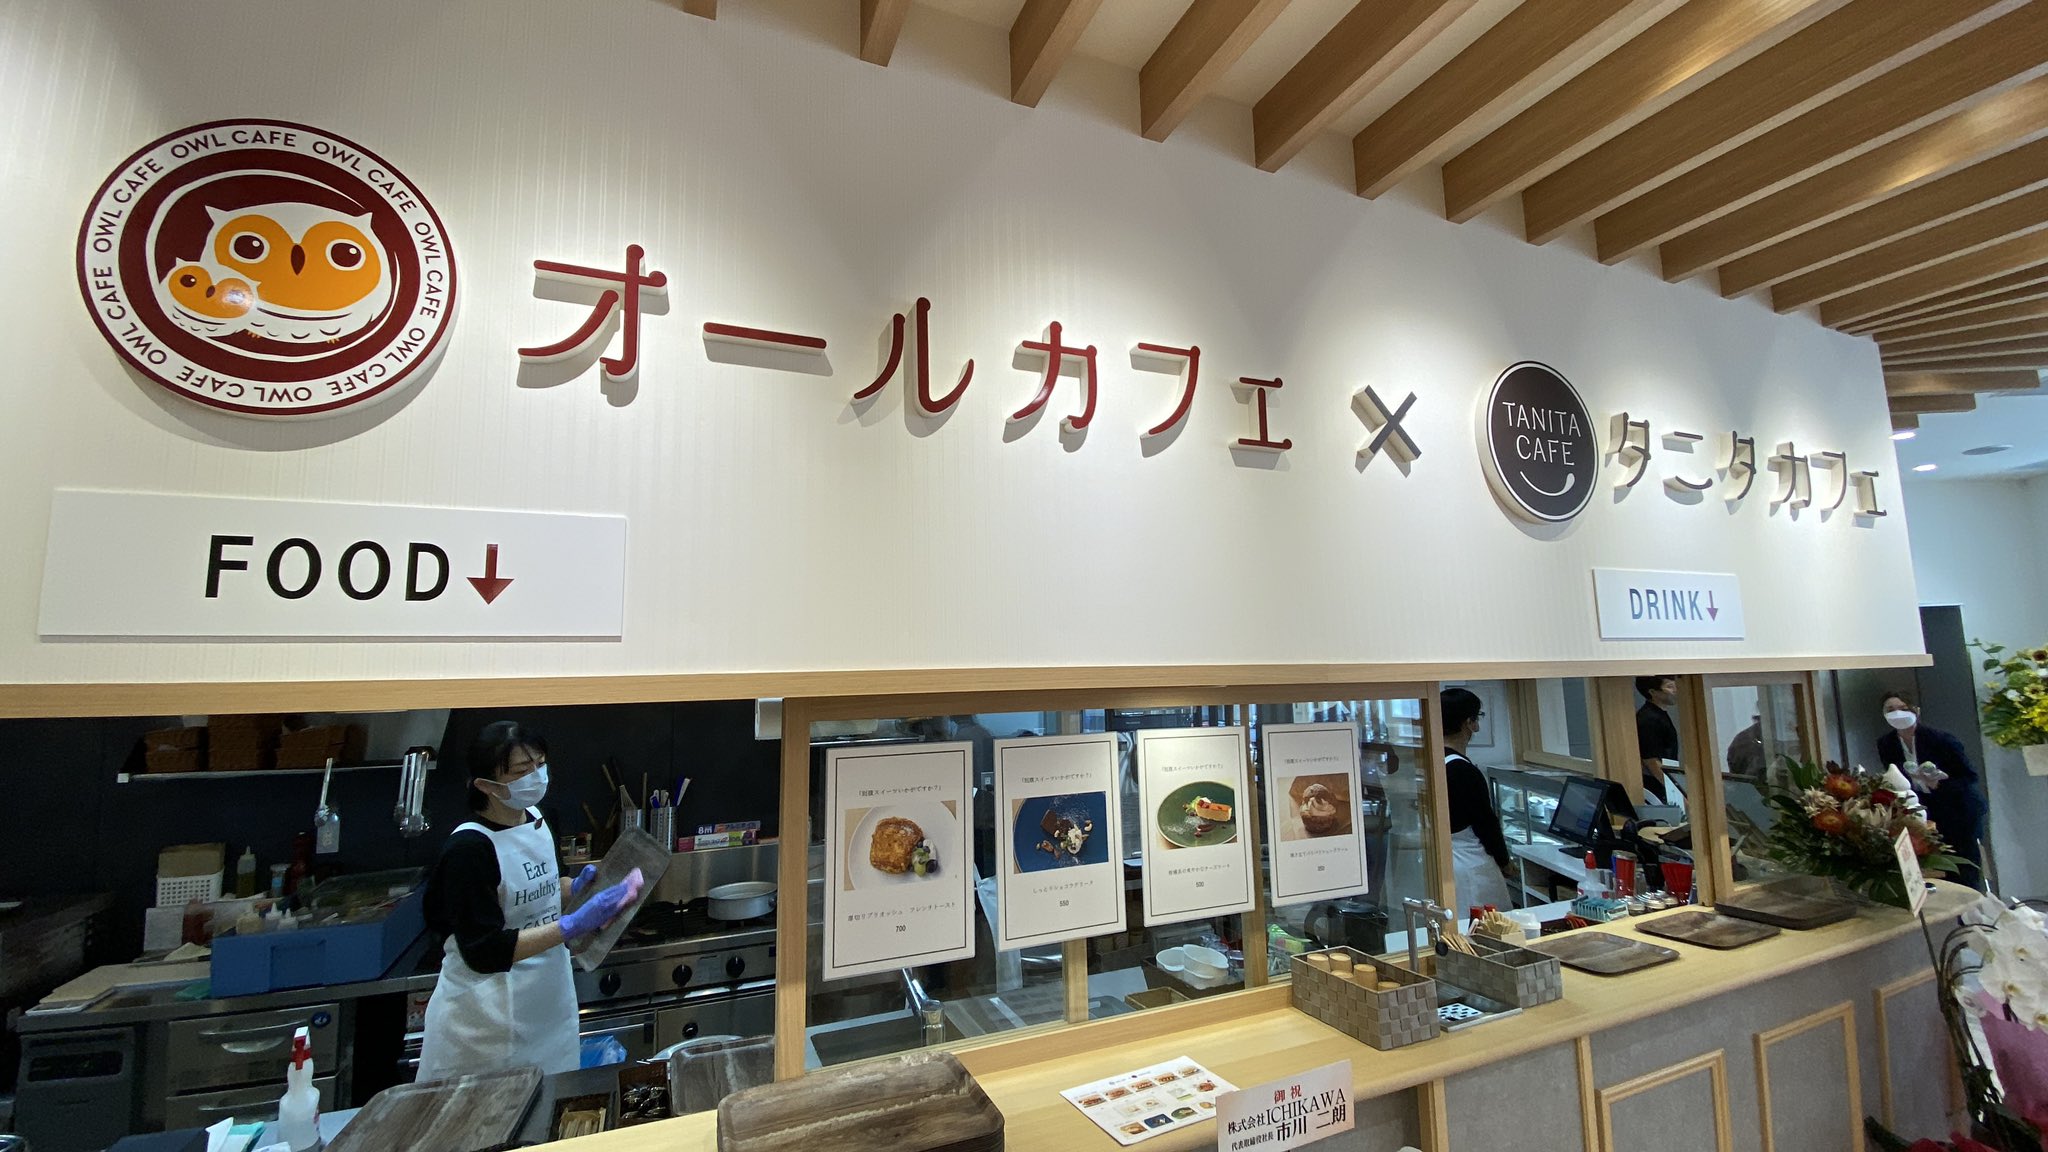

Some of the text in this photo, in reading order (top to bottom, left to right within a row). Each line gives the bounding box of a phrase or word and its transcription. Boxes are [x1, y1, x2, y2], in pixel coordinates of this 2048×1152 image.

[169, 130, 297, 159] OWL CAFE
[312, 141, 418, 213] OWL CAFE
[93, 158, 164, 253] OWL CAFE
[414, 222, 443, 319] OWL CAFE
[92, 265, 168, 365] OWL CAFE
[326, 327, 426, 396] OWL CAFE
[517, 243, 1293, 450] オールカフェ
[175, 365, 313, 402] OWL CAFE
[1502, 401, 1582, 438] TANITA
[1515, 434, 1575, 467] CAFE
[1614, 411, 1888, 518] タニタカフェ
[205, 534, 450, 601] FOOD
[1629, 588, 1704, 622] DRINK
[522, 861, 549, 881] Eat
[514, 880, 558, 907] Healthy
[895, 924, 907, 933] 700
[1265, 1088, 1346, 1126] ICHIKAWA
